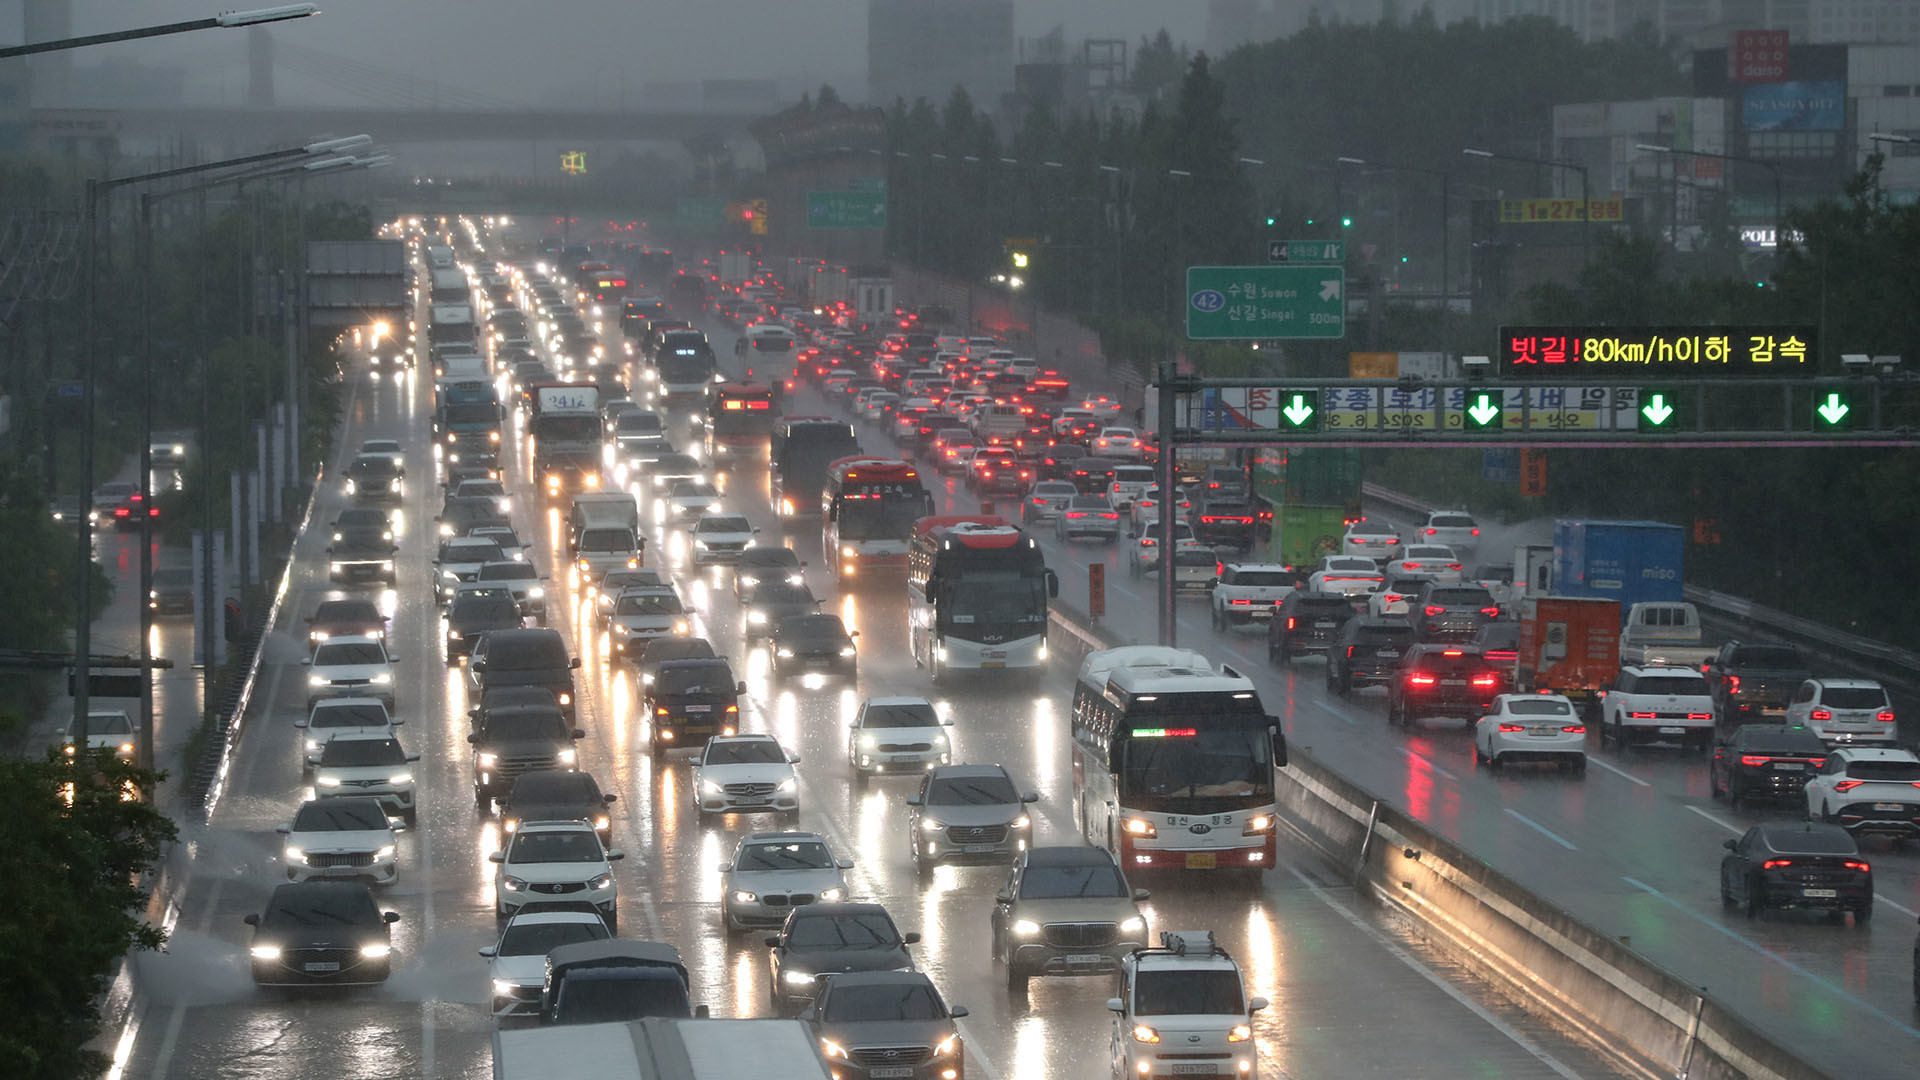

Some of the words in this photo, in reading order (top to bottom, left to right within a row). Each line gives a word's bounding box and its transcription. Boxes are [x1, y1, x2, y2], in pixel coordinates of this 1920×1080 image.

[1743, 64, 1784, 77] daiso
[1271, 246, 1287, 258] 44
[1227, 283, 1257, 300] 수원
[1261, 288, 1297, 299] Suwon
[1197, 294, 1218, 309] 42
[1227, 304, 1257, 321] 신갈
[1261, 309, 1295, 322] Singal
[1309, 313, 1341, 324] 300m
[1749, 335, 1807, 363] 감속
[1641, 566, 1676, 580] miso
[1167, 816, 1188, 826] 대신
[1211, 815, 1232, 825] 항공
